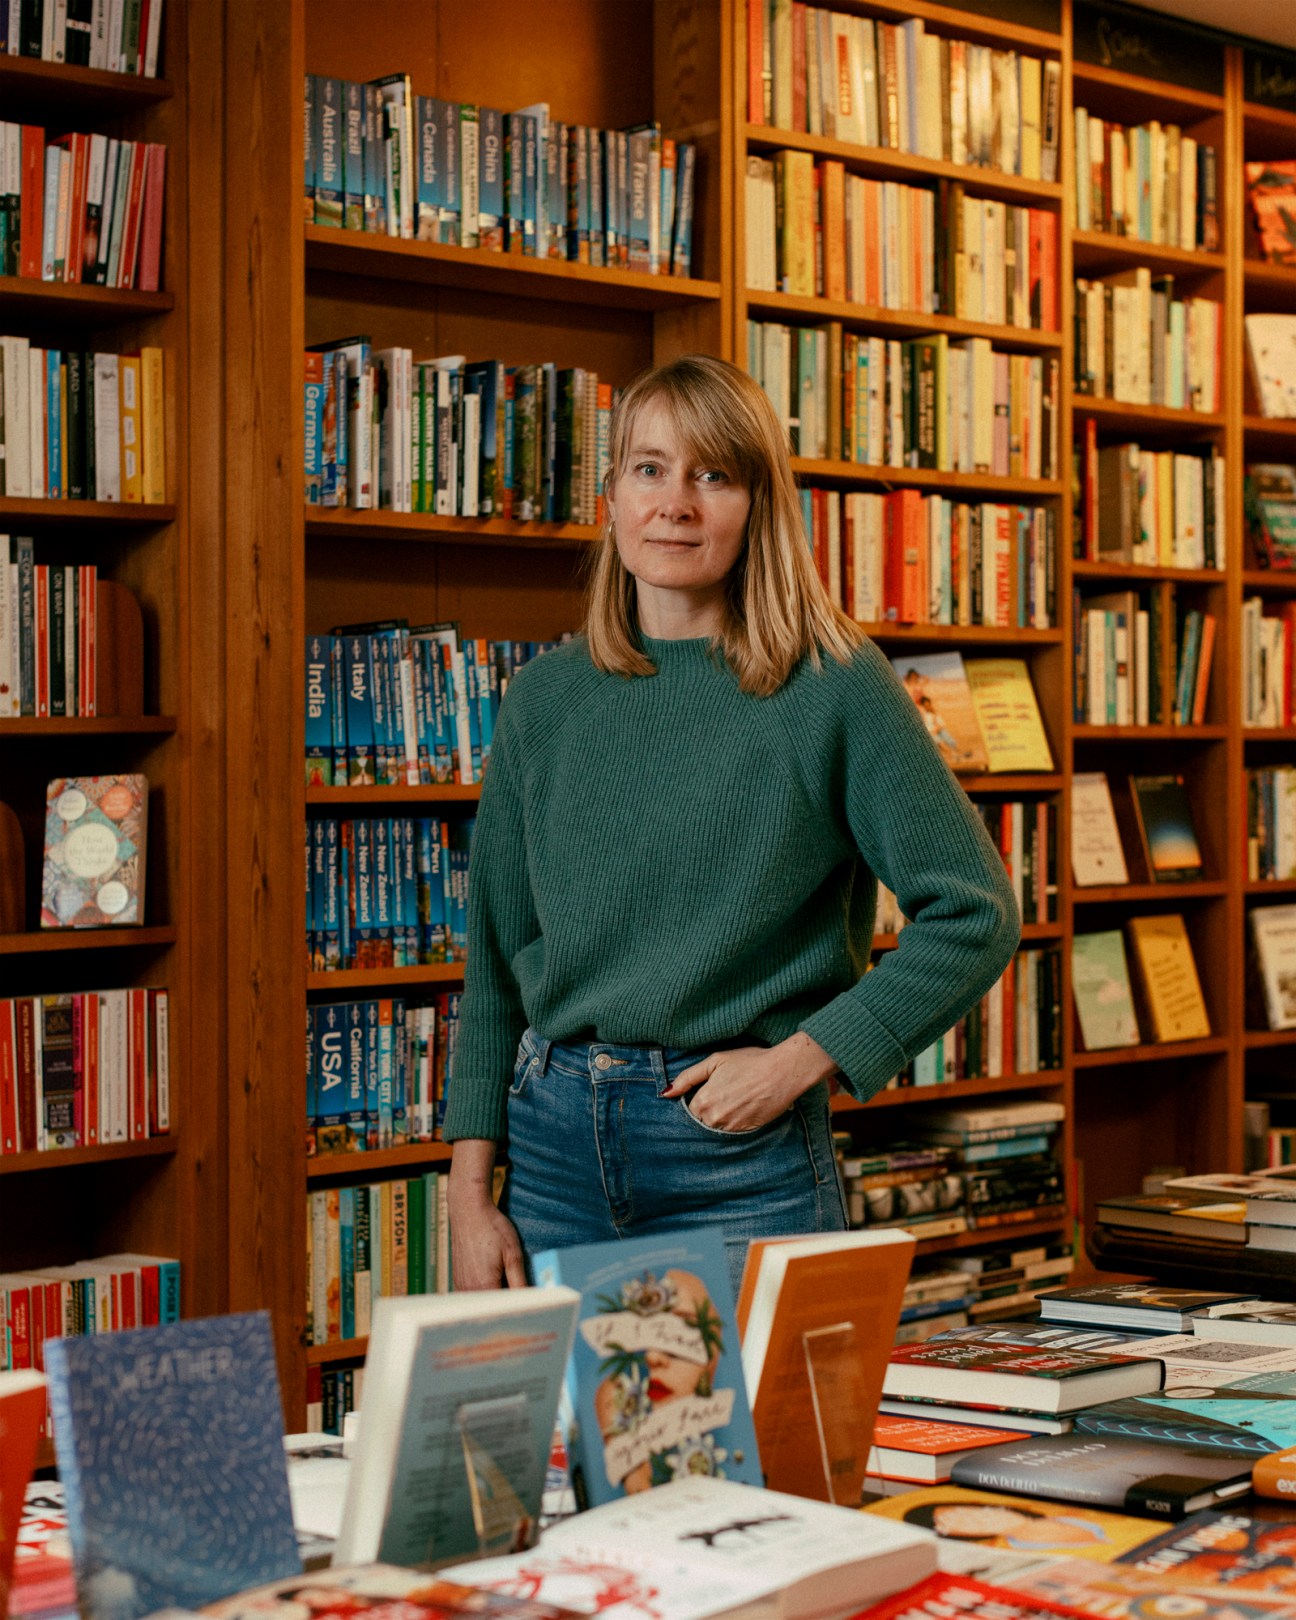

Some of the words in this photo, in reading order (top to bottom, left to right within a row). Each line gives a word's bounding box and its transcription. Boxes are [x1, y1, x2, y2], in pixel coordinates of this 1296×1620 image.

[322, 104, 337, 182] Australia
[349, 110, 361, 155] Brazil
[423, 122, 437, 185] Canada
[485, 135, 498, 182] China
[511, 139, 521, 170] Costa
[511, 172, 521, 195] Rica
[633, 162, 646, 221] France
[71, 358, 79, 392] PLATO
[303, 386, 319, 472] Germany
[411, 396, 420, 444] COUNTRY
[425, 397, 434, 444] COUNTRY
[411, 446, 420, 481] WALKS
[425, 446, 434, 481] WALKS
[55, 572, 63, 589] ON
[55, 591, 63, 615] WAR
[309, 663, 325, 718] India
[350, 663, 365, 702] Italy
[373, 662, 382, 703] Southern
[394, 680, 402, 706] Italian
[480, 666, 489, 699] SICILY
[489, 665, 498, 692] Sicily
[375, 704, 384, 724] Italy
[414, 664, 422, 689] Venice
[418, 712, 426, 739] Veneto
[395, 708, 403, 732] Lakes
[435, 706, 443, 738] Tuscany
[315, 847, 324, 874] Nepal
[328, 847, 336, 864] The
[359, 845, 369, 872] New
[377, 845, 387, 872] New
[405, 844, 414, 880] Norway
[431, 843, 440, 874] Peru
[328, 866, 336, 923] Netherlands
[359, 874, 370, 923] Zealand
[378, 874, 388, 922] Zealand
[368, 1027, 377, 1048] New
[381, 1027, 391, 1051] NEW
[321, 1032, 342, 1092] USA
[350, 1027, 362, 1099] California
[369, 1050, 377, 1069] York
[381, 1052, 391, 1080] YORK
[368, 1071, 378, 1092] City
[381, 1081, 391, 1105] CITY
[394, 1193, 405, 1246] BRYSON
[167, 1276, 177, 1313] POSH
[114, 1346, 234, 1392] WEATHER
[999, 1449, 1052, 1463] DON
[978, 1472, 998, 1486] DON
